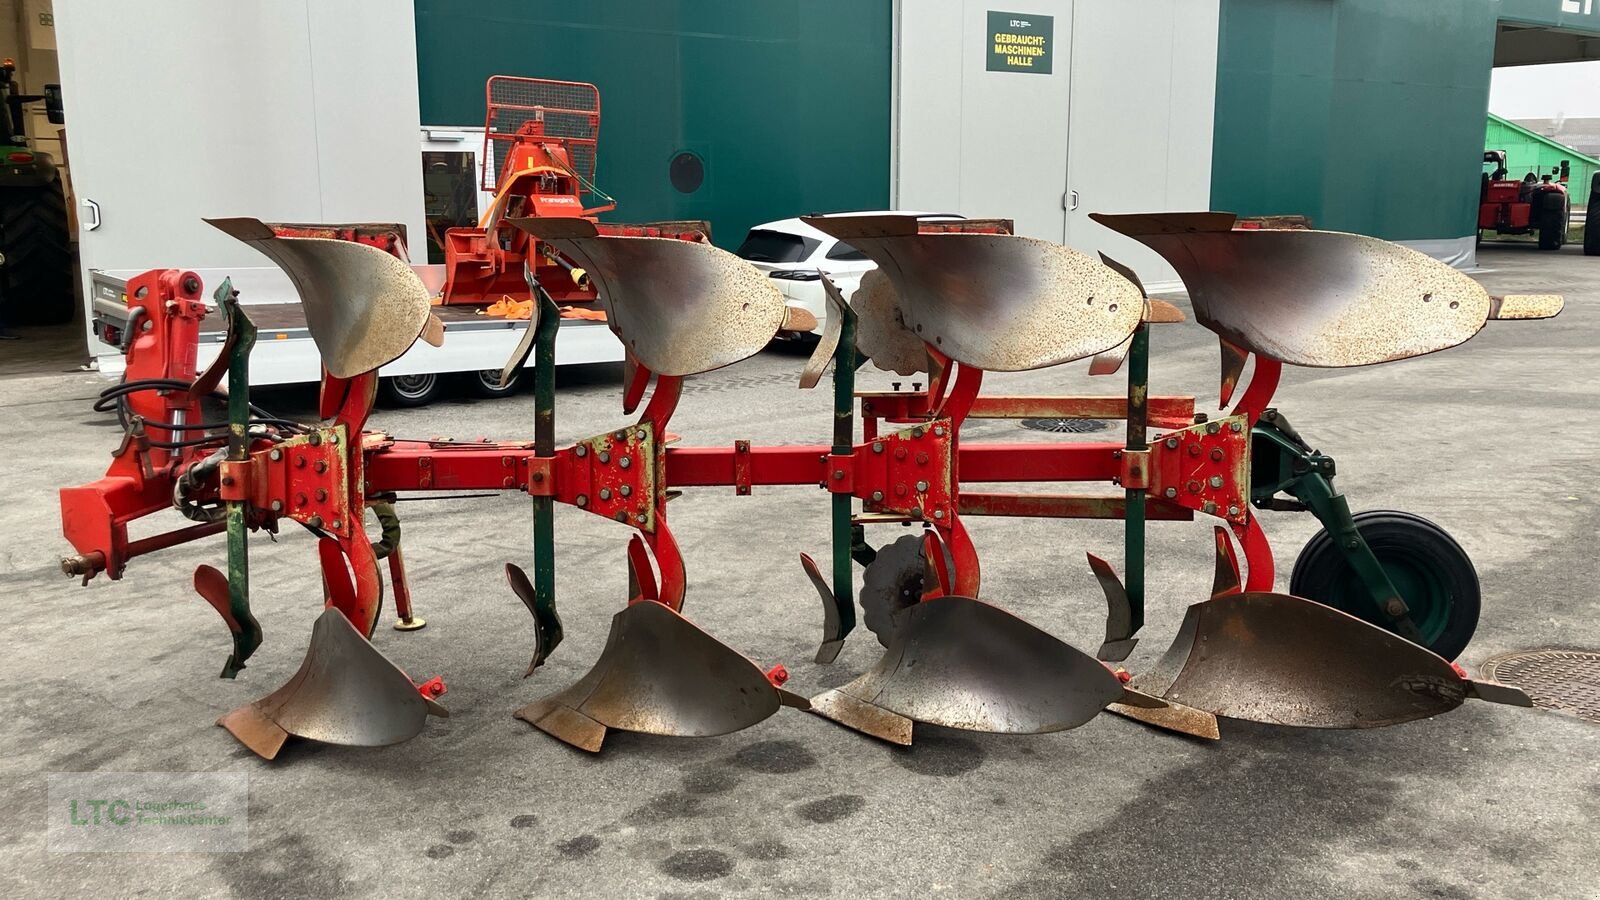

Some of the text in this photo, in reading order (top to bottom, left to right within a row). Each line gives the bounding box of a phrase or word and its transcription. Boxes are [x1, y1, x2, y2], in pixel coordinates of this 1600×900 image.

[1010, 20, 1020, 28] LTC
[994, 33, 1046, 46] GEBRAUCHT-
[994, 44, 1046, 56] MASCHINEN-
[1007, 56, 1033, 66] HALLE
